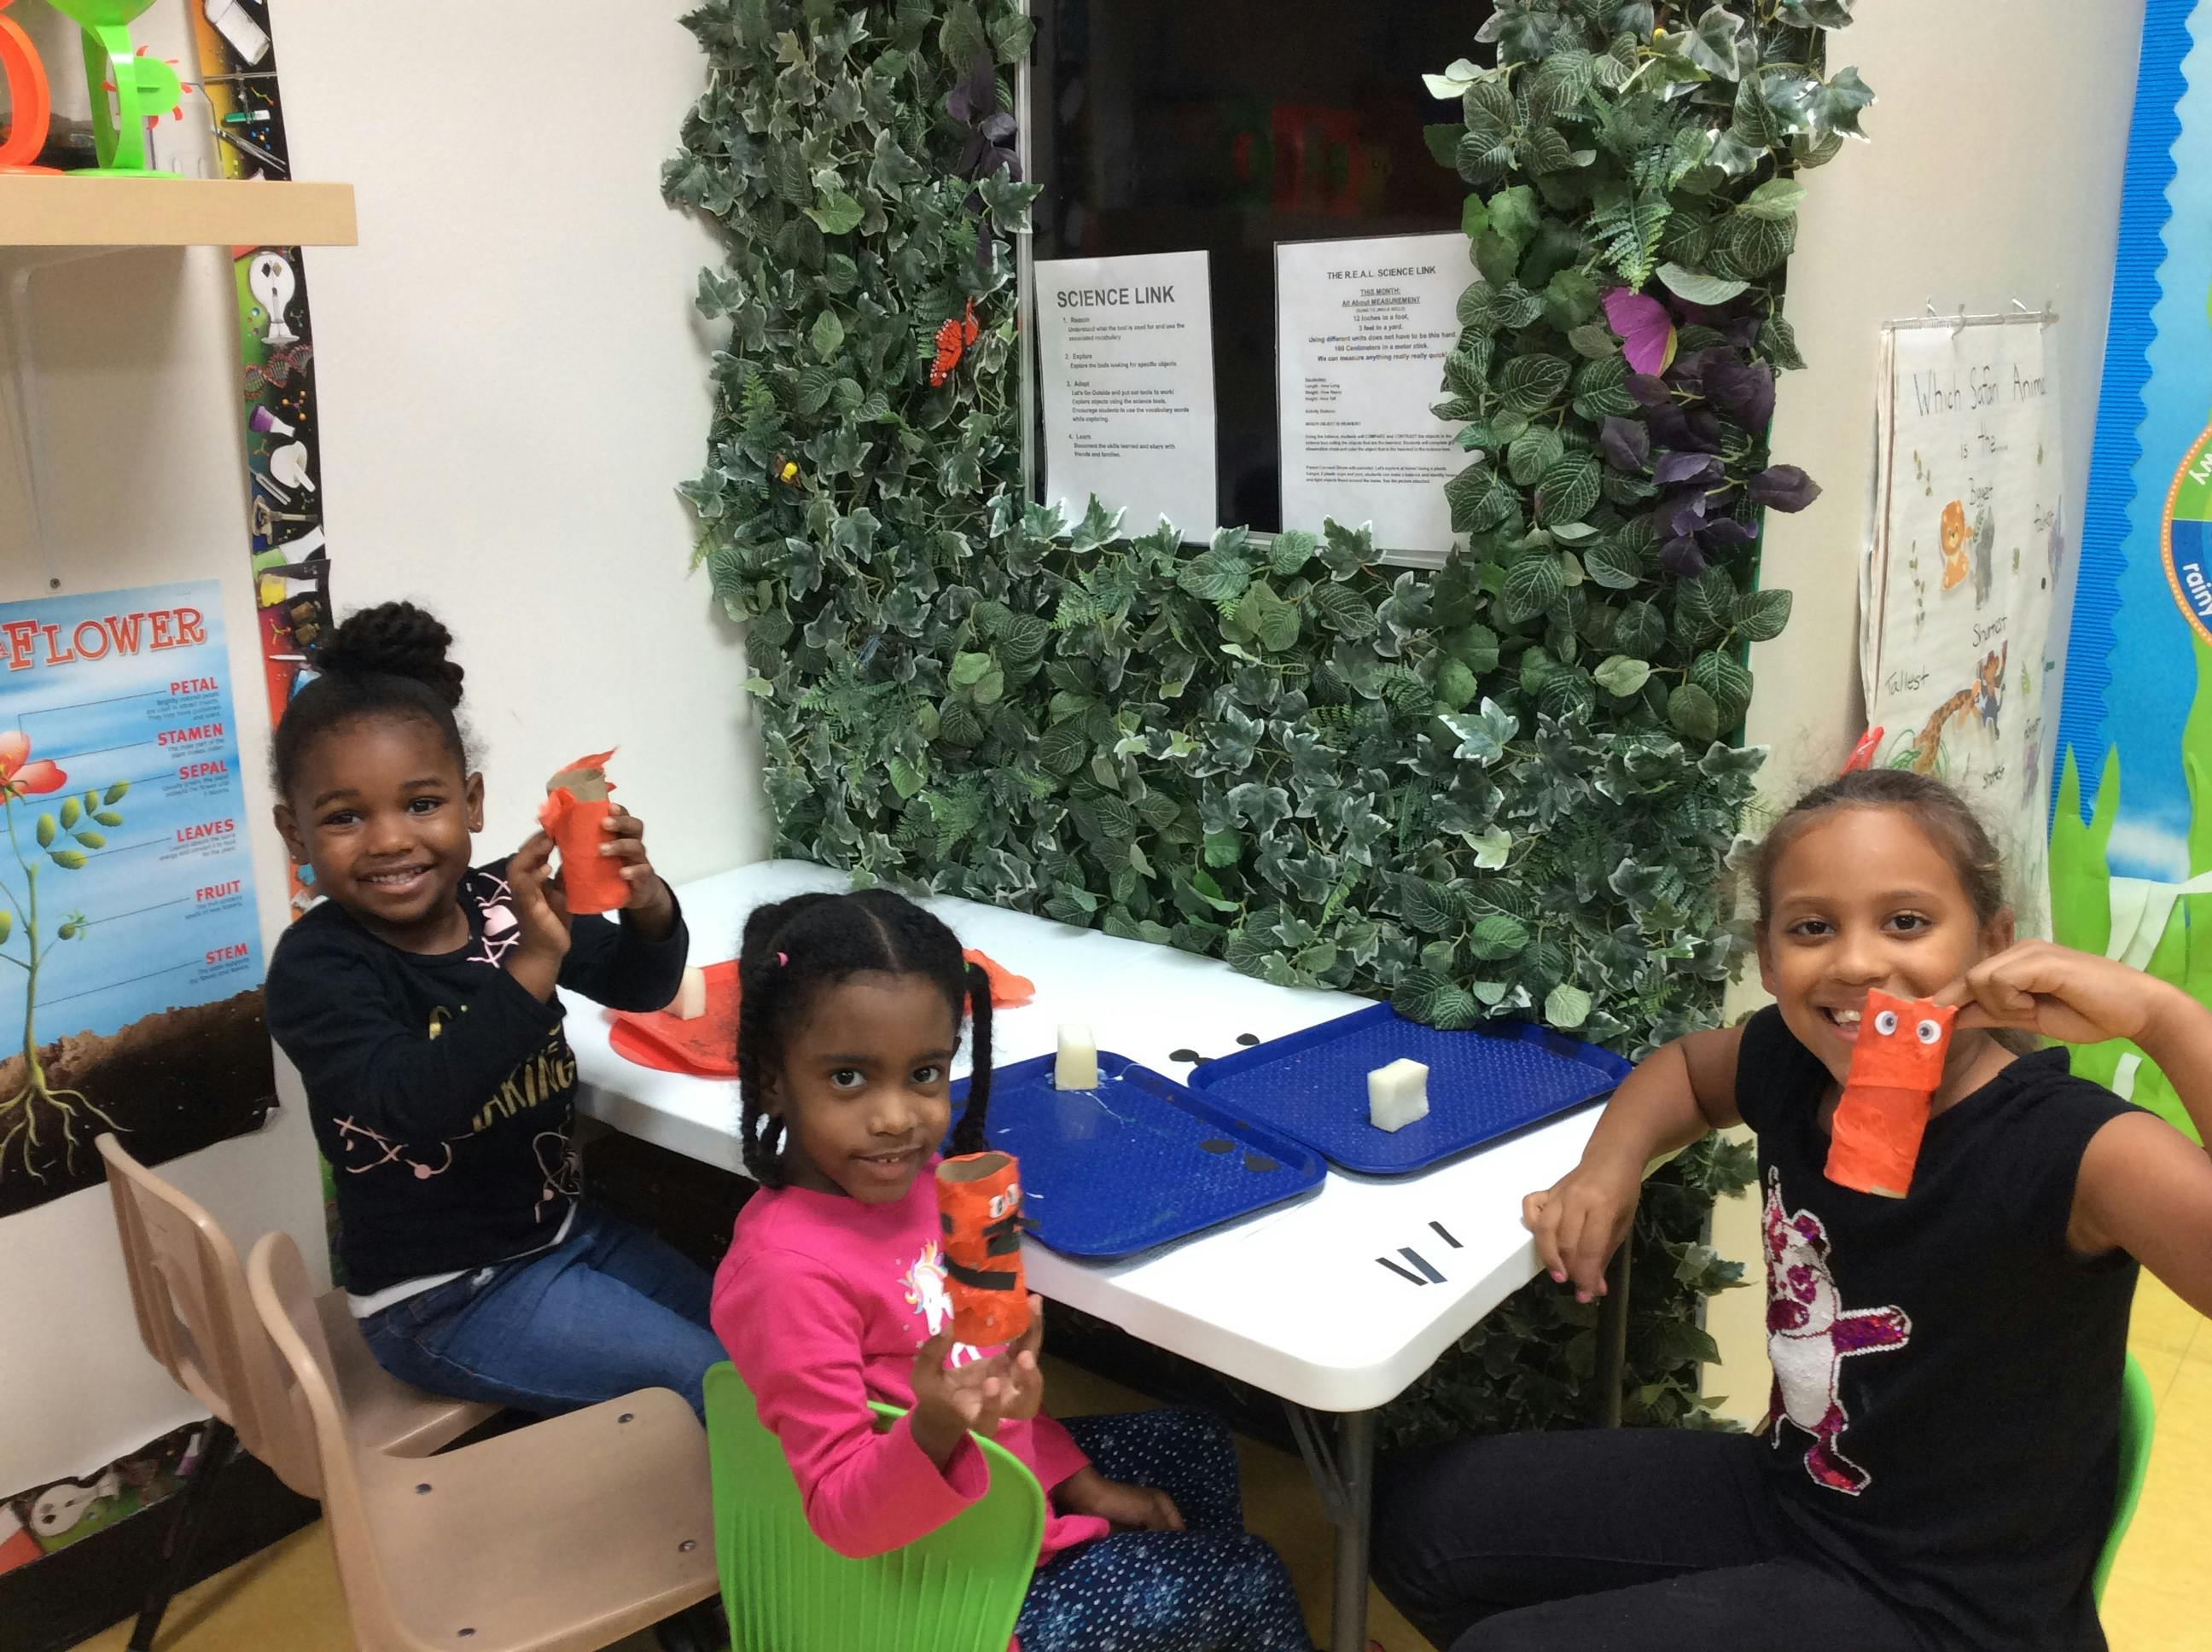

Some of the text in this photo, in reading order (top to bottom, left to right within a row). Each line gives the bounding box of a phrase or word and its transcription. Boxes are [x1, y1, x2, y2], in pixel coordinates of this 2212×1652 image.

[1327, 271, 1344, 280] THE
[1377, 267, 1414, 277] SCIENCE
[1416, 265, 1436, 275] LINK
[1057, 286, 1175, 308] SCIENCE LINK
[1371, 296, 1421, 306] MEASUREMENT
[1365, 353, 1392, 362] anything
[1393, 352, 1409, 361] really
[1411, 352, 1427, 361] really
[1913, 368, 1962, 417] Which
[1969, 365, 2000, 410] Safari
[1960, 443, 1968, 461] is
[2182, 563, 2212, 616] rainy
[1, 607, 207, 671] FLOWER
[170, 677, 218, 695] PETAL
[1885, 662, 1930, 695] Tallest
[157, 723, 224, 747] STAMEN
[179, 759, 228, 780] SEPAL
[176, 818, 235, 843] LEAVES
[195, 880, 242, 902] FRUIT
[205, 942, 248, 966] STEM
